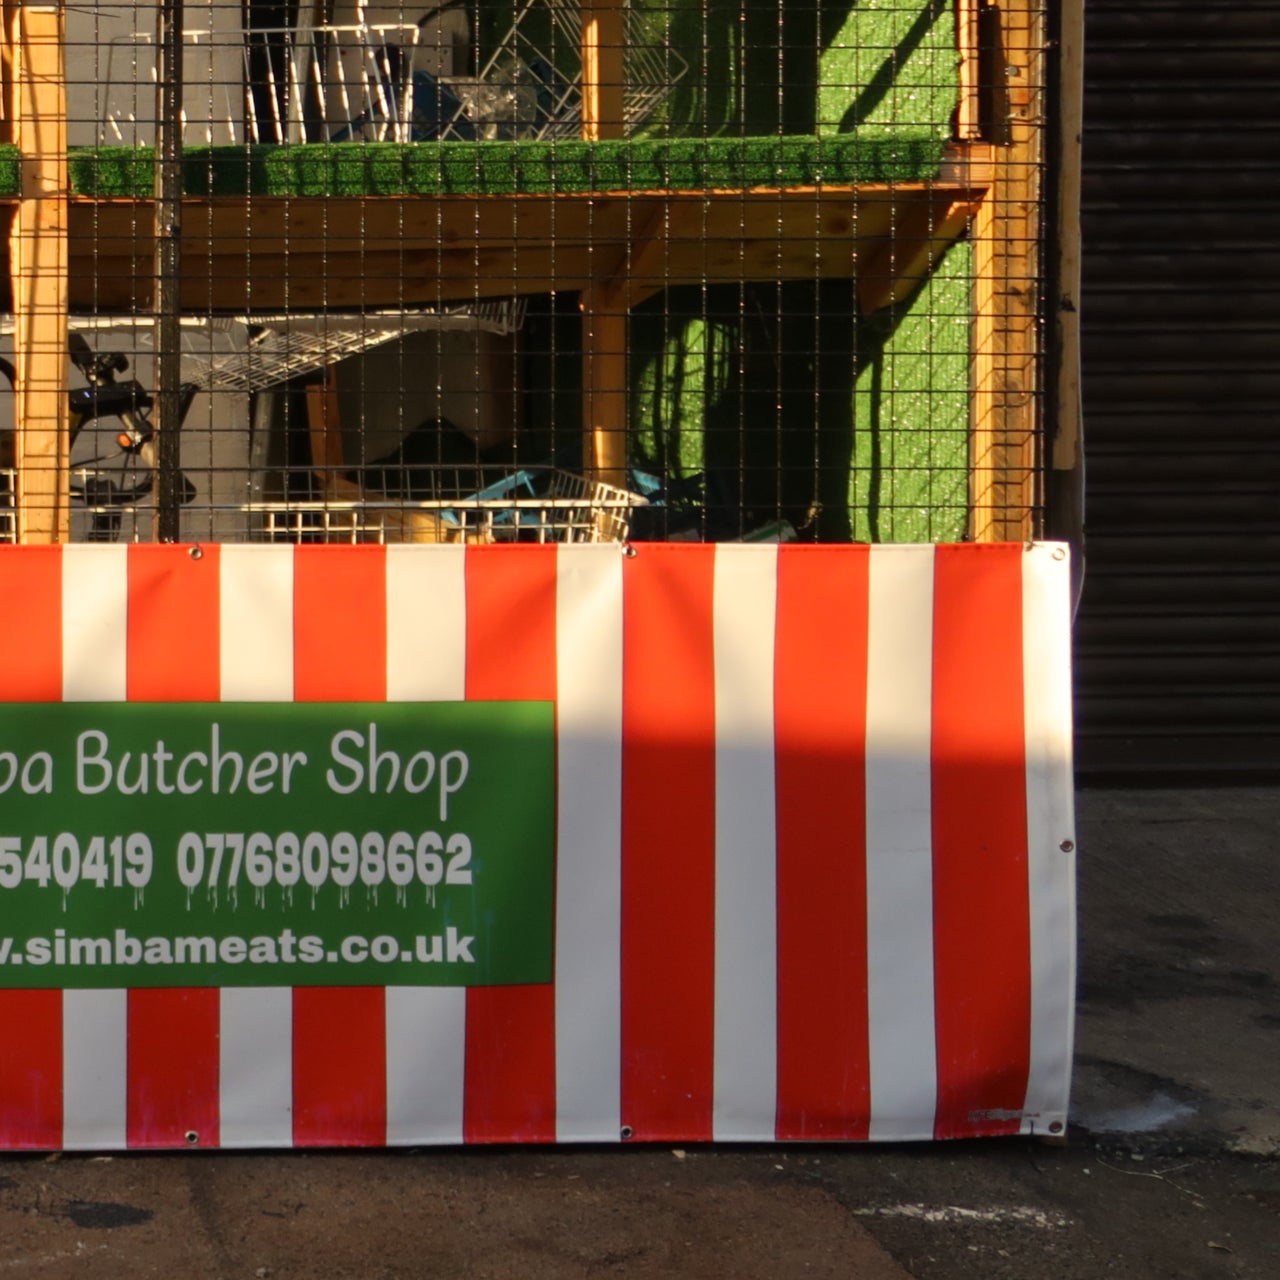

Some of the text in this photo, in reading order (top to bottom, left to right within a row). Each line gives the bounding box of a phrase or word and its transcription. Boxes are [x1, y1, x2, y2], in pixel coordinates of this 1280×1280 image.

[76, 723, 308, 795] Butcher
[326, 722, 469, 822] Shop
[177, 832, 473, 906] 07768098662
